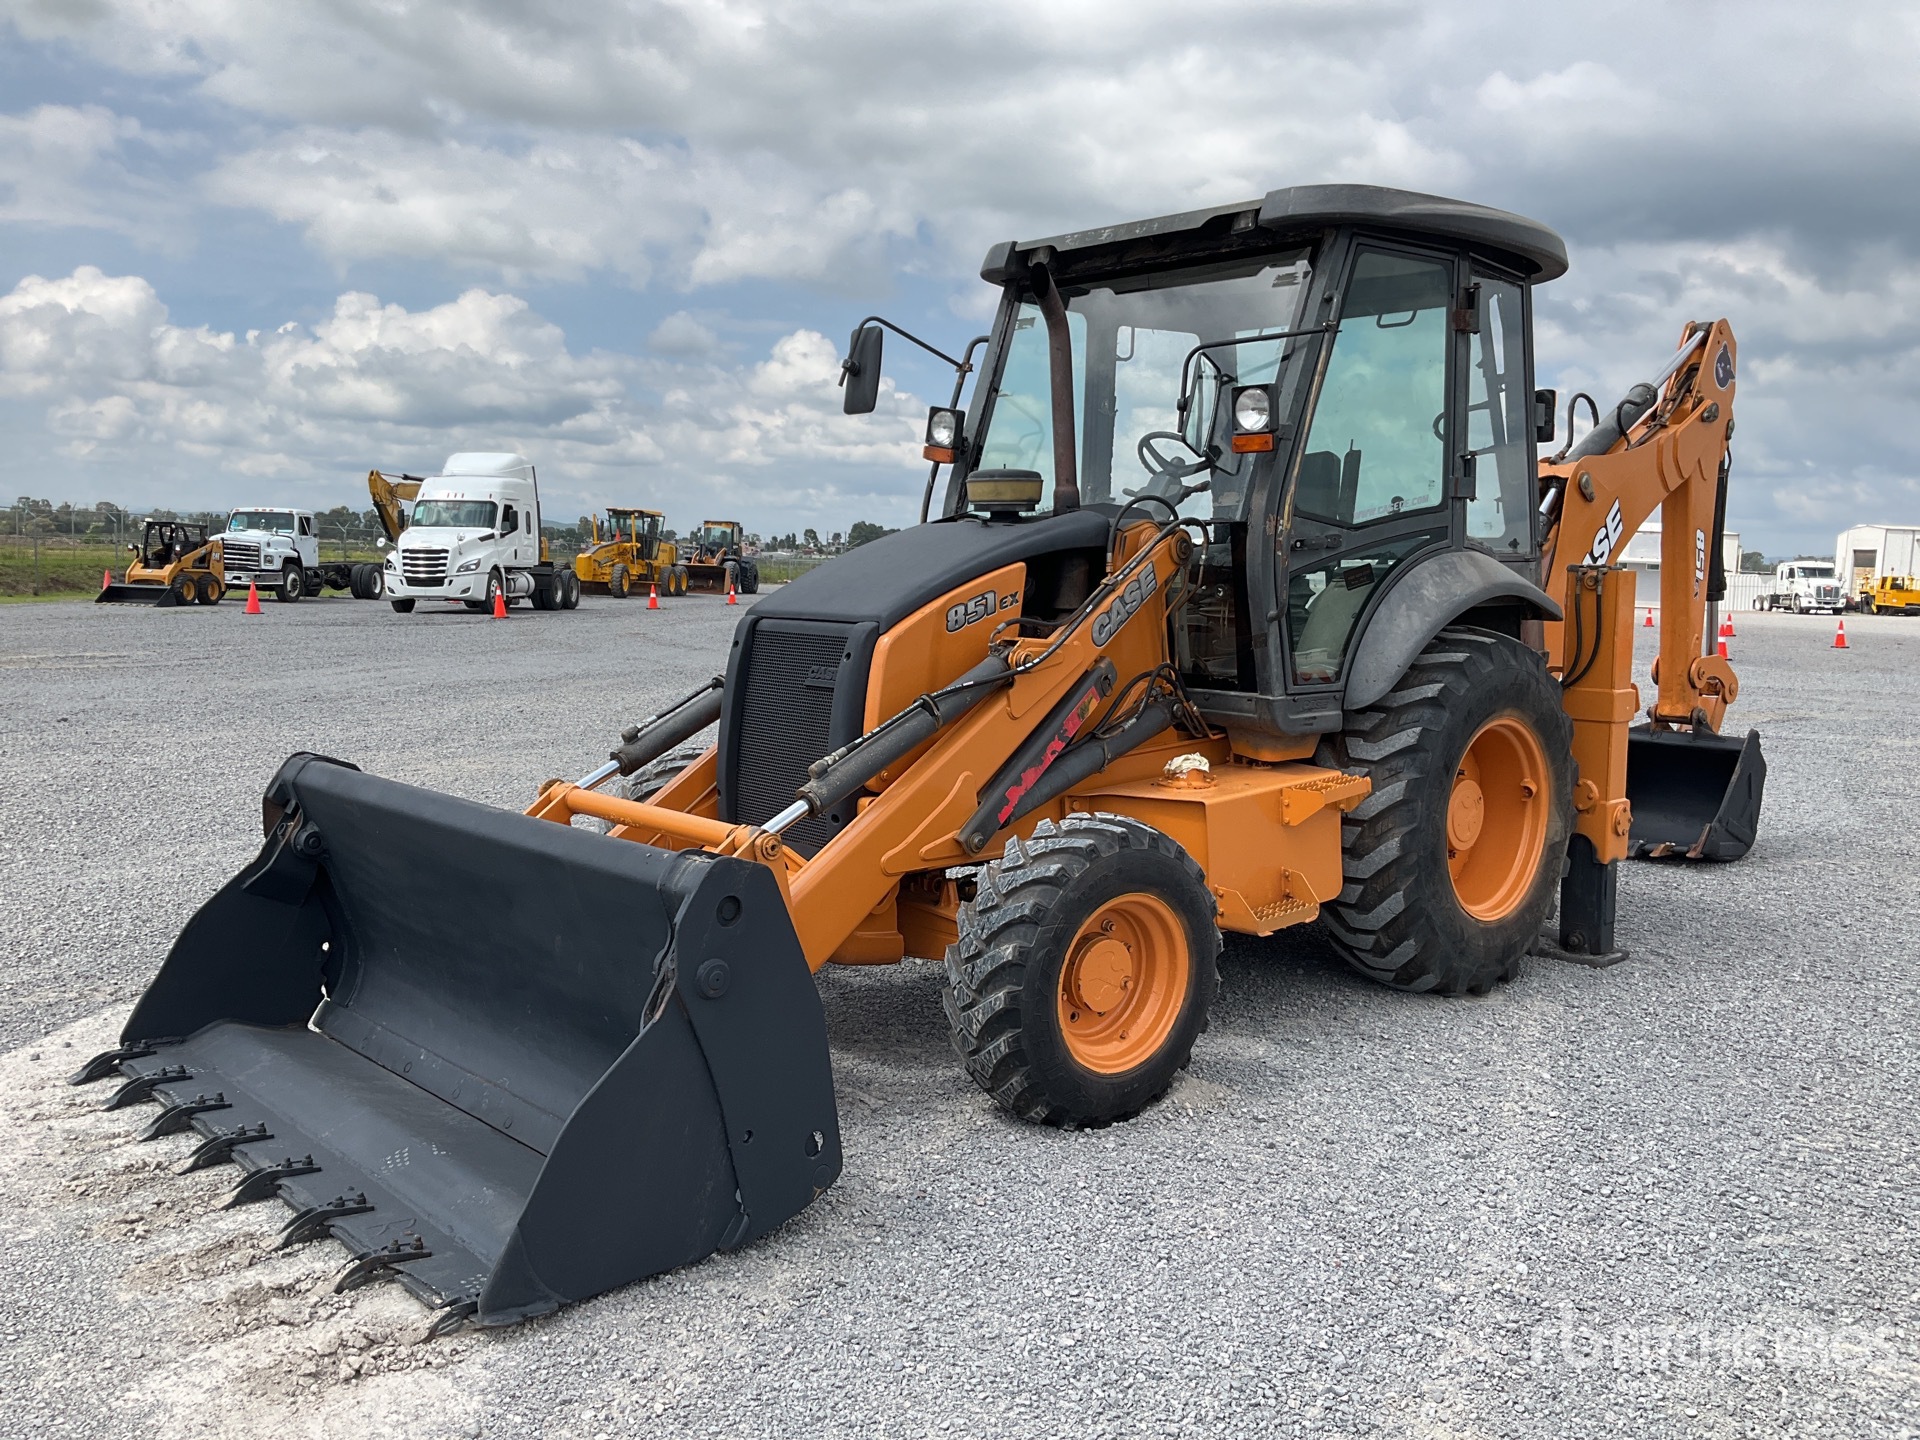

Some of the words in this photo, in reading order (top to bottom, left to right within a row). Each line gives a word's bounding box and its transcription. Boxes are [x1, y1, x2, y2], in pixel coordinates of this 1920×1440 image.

[1695, 527, 1706, 581] 851
[946, 590, 996, 632] 851
[1000, 591, 1019, 610] EX
[1091, 560, 1158, 648] CASE
[808, 666, 837, 681] CAS
